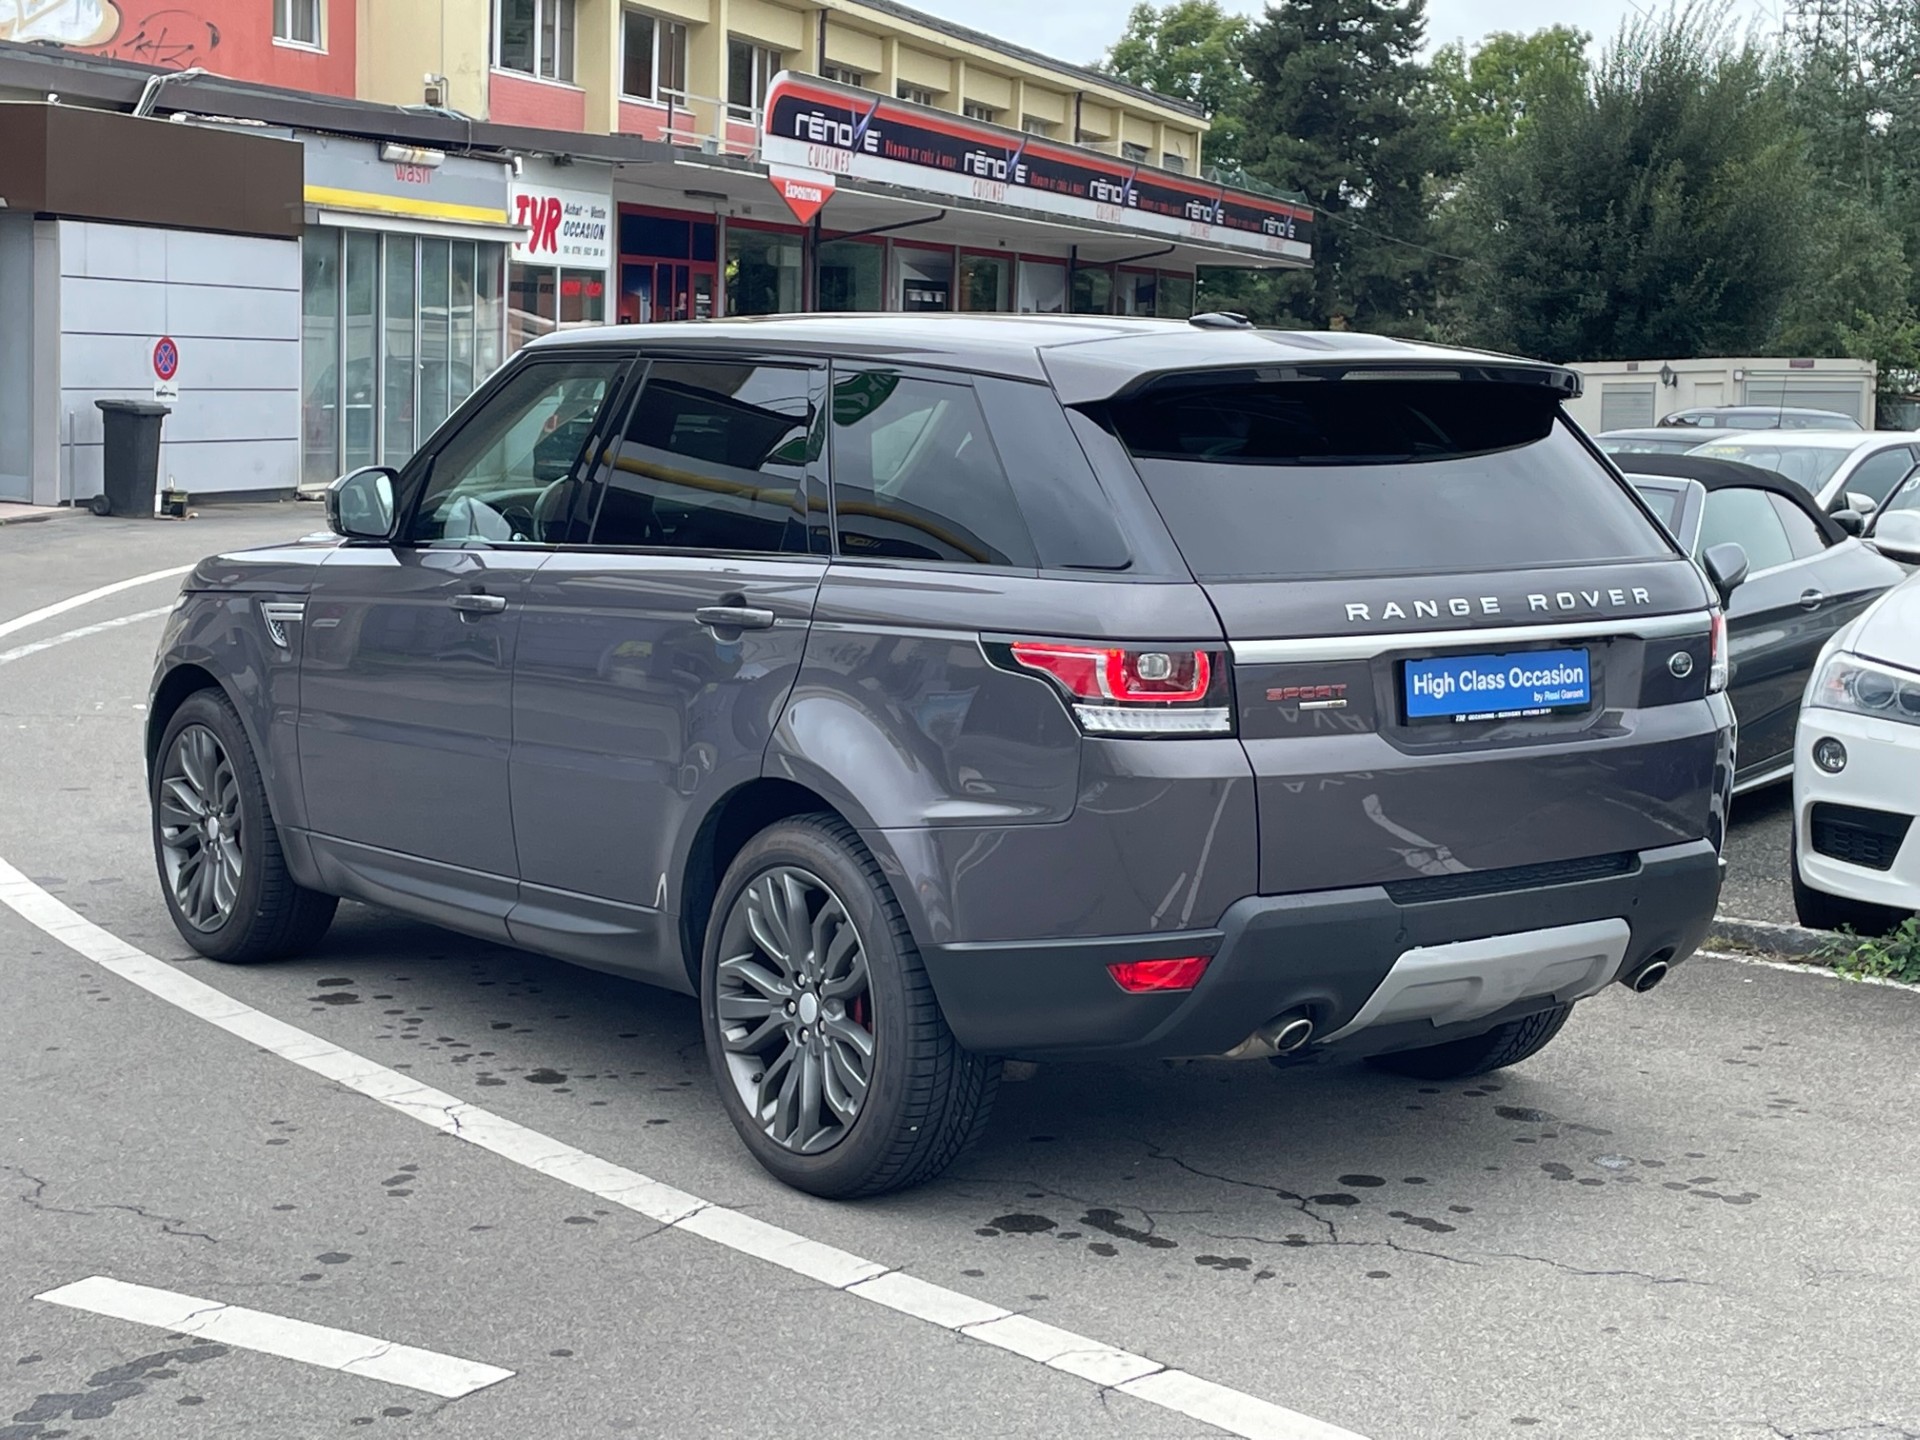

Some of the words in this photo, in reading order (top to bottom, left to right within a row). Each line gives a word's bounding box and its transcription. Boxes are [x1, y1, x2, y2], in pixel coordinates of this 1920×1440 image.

[808, 145, 850, 172] CUISINES
[515, 195, 562, 254] TYR
[563, 220, 606, 240] OCCASION
[1345, 596, 1502, 621] RANGE
[1528, 587, 1651, 611] ROVER
[1266, 683, 1347, 701] SPORT
[1414, 672, 1456, 699] High
[1459, 670, 1506, 691] Class
[1509, 663, 1584, 688] Occasion
[1533, 691, 1544, 703] by
